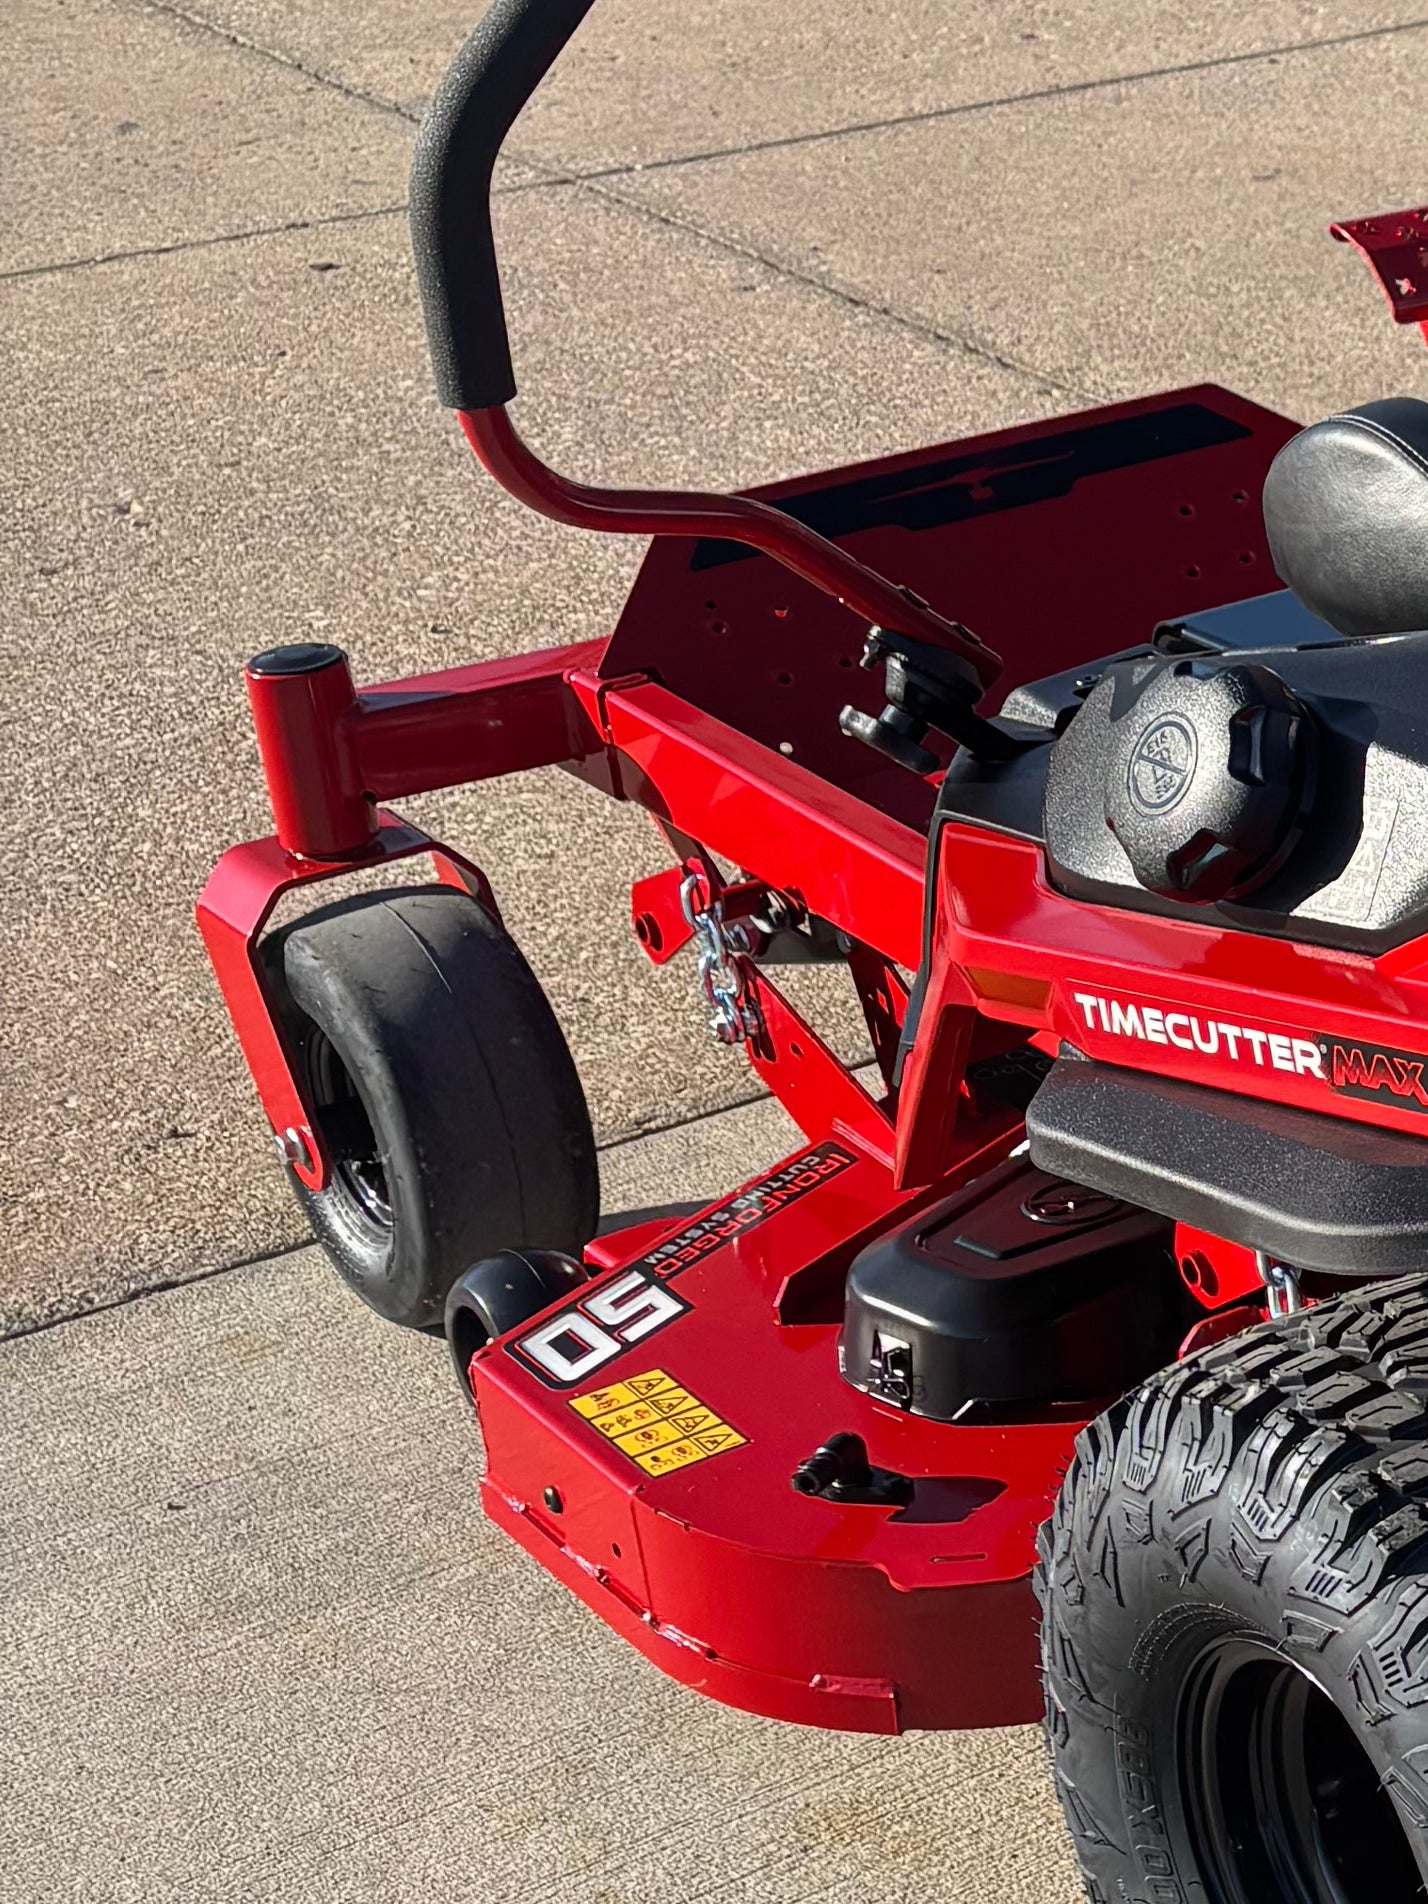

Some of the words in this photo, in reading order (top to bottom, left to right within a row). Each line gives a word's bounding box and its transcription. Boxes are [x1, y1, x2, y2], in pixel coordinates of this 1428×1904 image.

[1073, 992, 1326, 1080] TIMECUTTER
[653, 1152, 850, 1278] IRONFORGED
[731, 1154, 820, 1210] CUTTING
[643, 1210, 730, 1265] SYSTEM
[520, 1270, 684, 1382] 50
